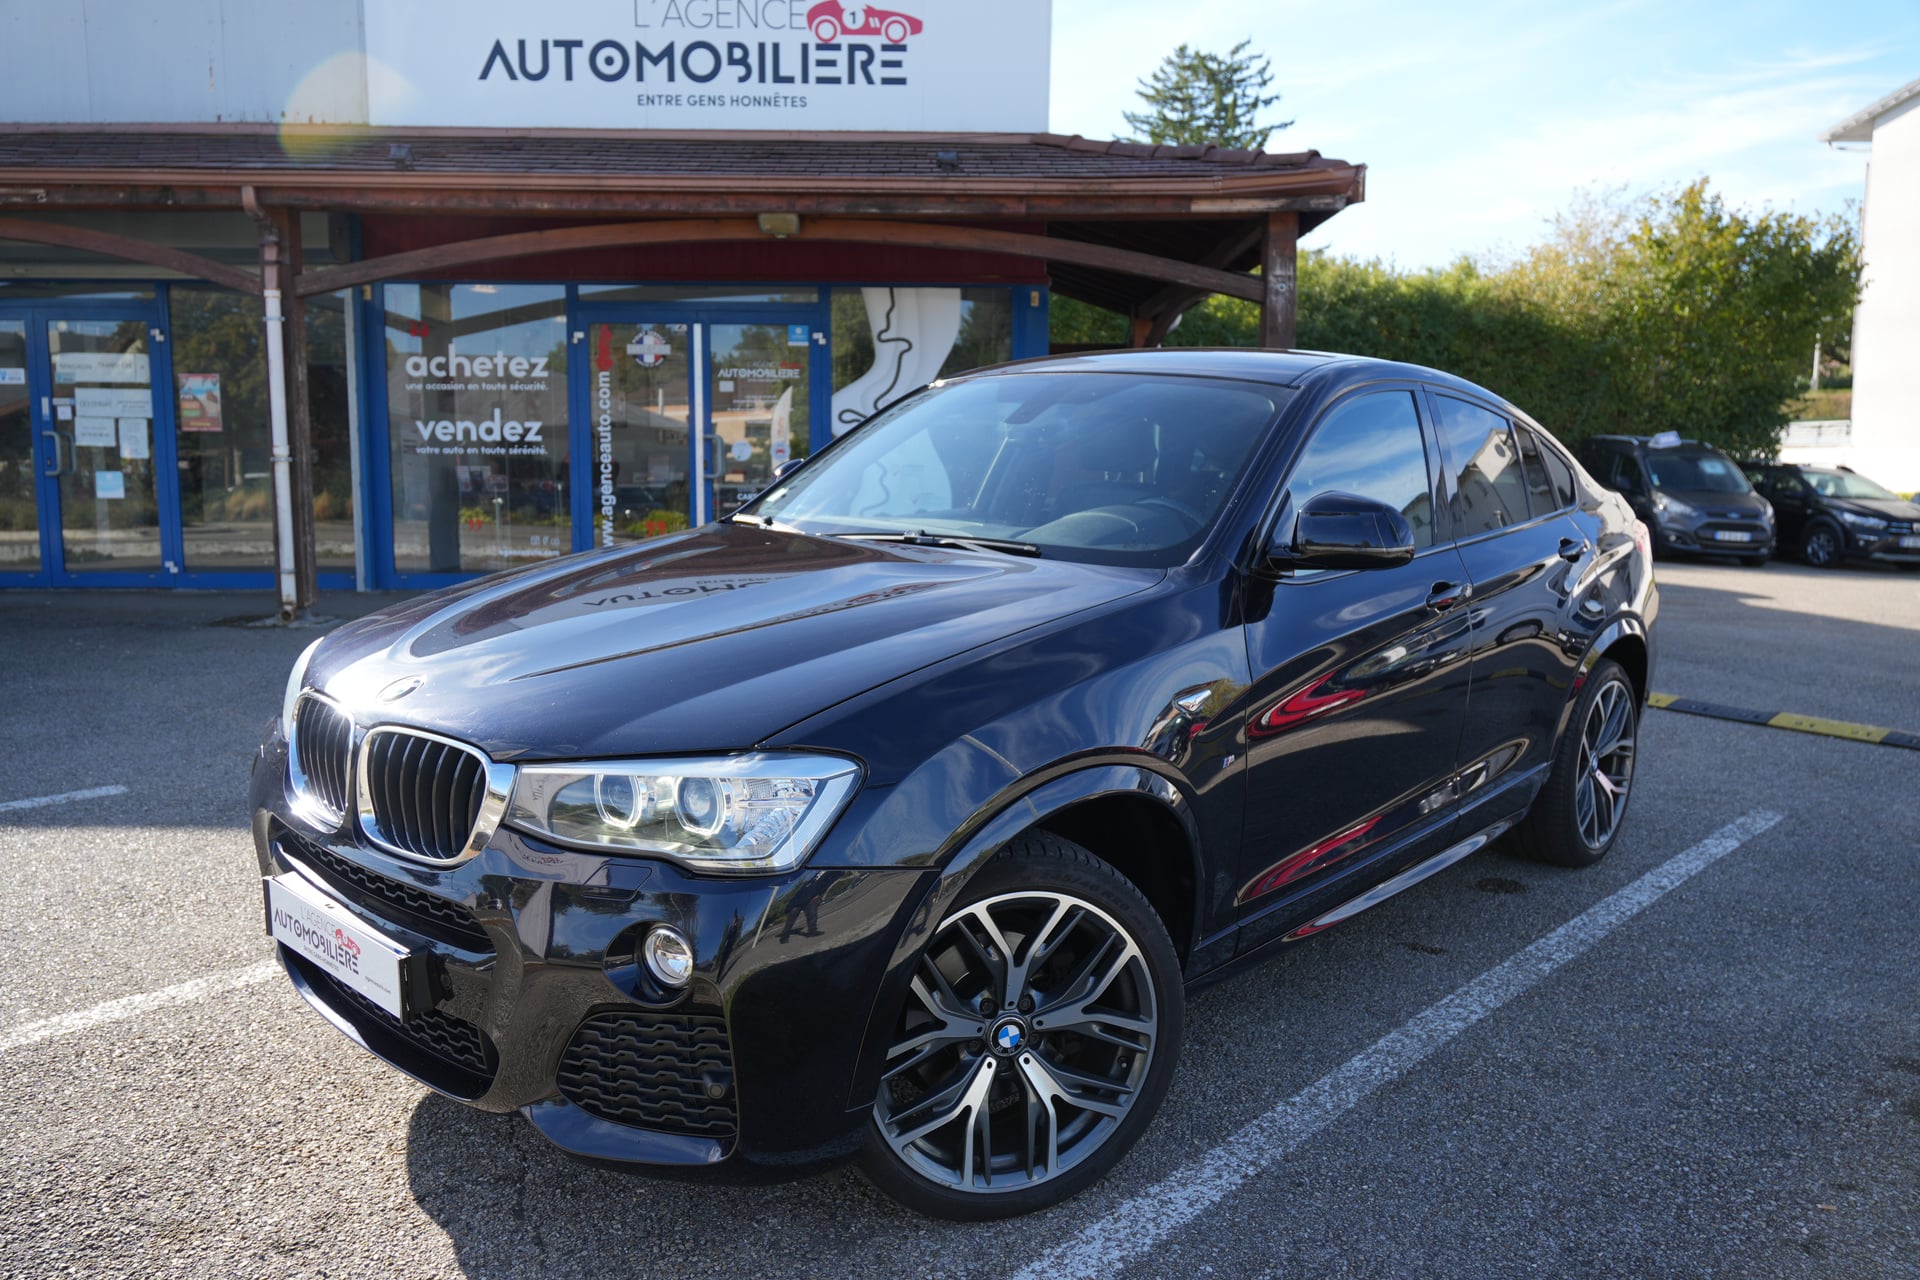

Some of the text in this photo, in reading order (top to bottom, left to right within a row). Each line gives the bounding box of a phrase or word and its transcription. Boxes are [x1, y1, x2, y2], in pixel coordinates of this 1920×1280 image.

[633, 0, 808, 30] L'AGENCE
[478, 38, 908, 86] AUTOMOBILIERE
[637, 92, 808, 108] ENTRE GENS HONNÊTES
[405, 343, 549, 378] achetez
[405, 383, 423, 391] une
[425, 381, 466, 391] occasion
[467, 383, 479, 391] en
[481, 382, 507, 391] toute
[415, 407, 543, 442] vendez
[415, 446, 440, 455] votre
[442, 446, 464, 455] auto
[466, 447, 478, 455] en
[481, 446, 506, 455] toute
[598, 370, 617, 547] ww.agenceauto.com
[274, 908, 359, 975] AUTOMOBILIERE
